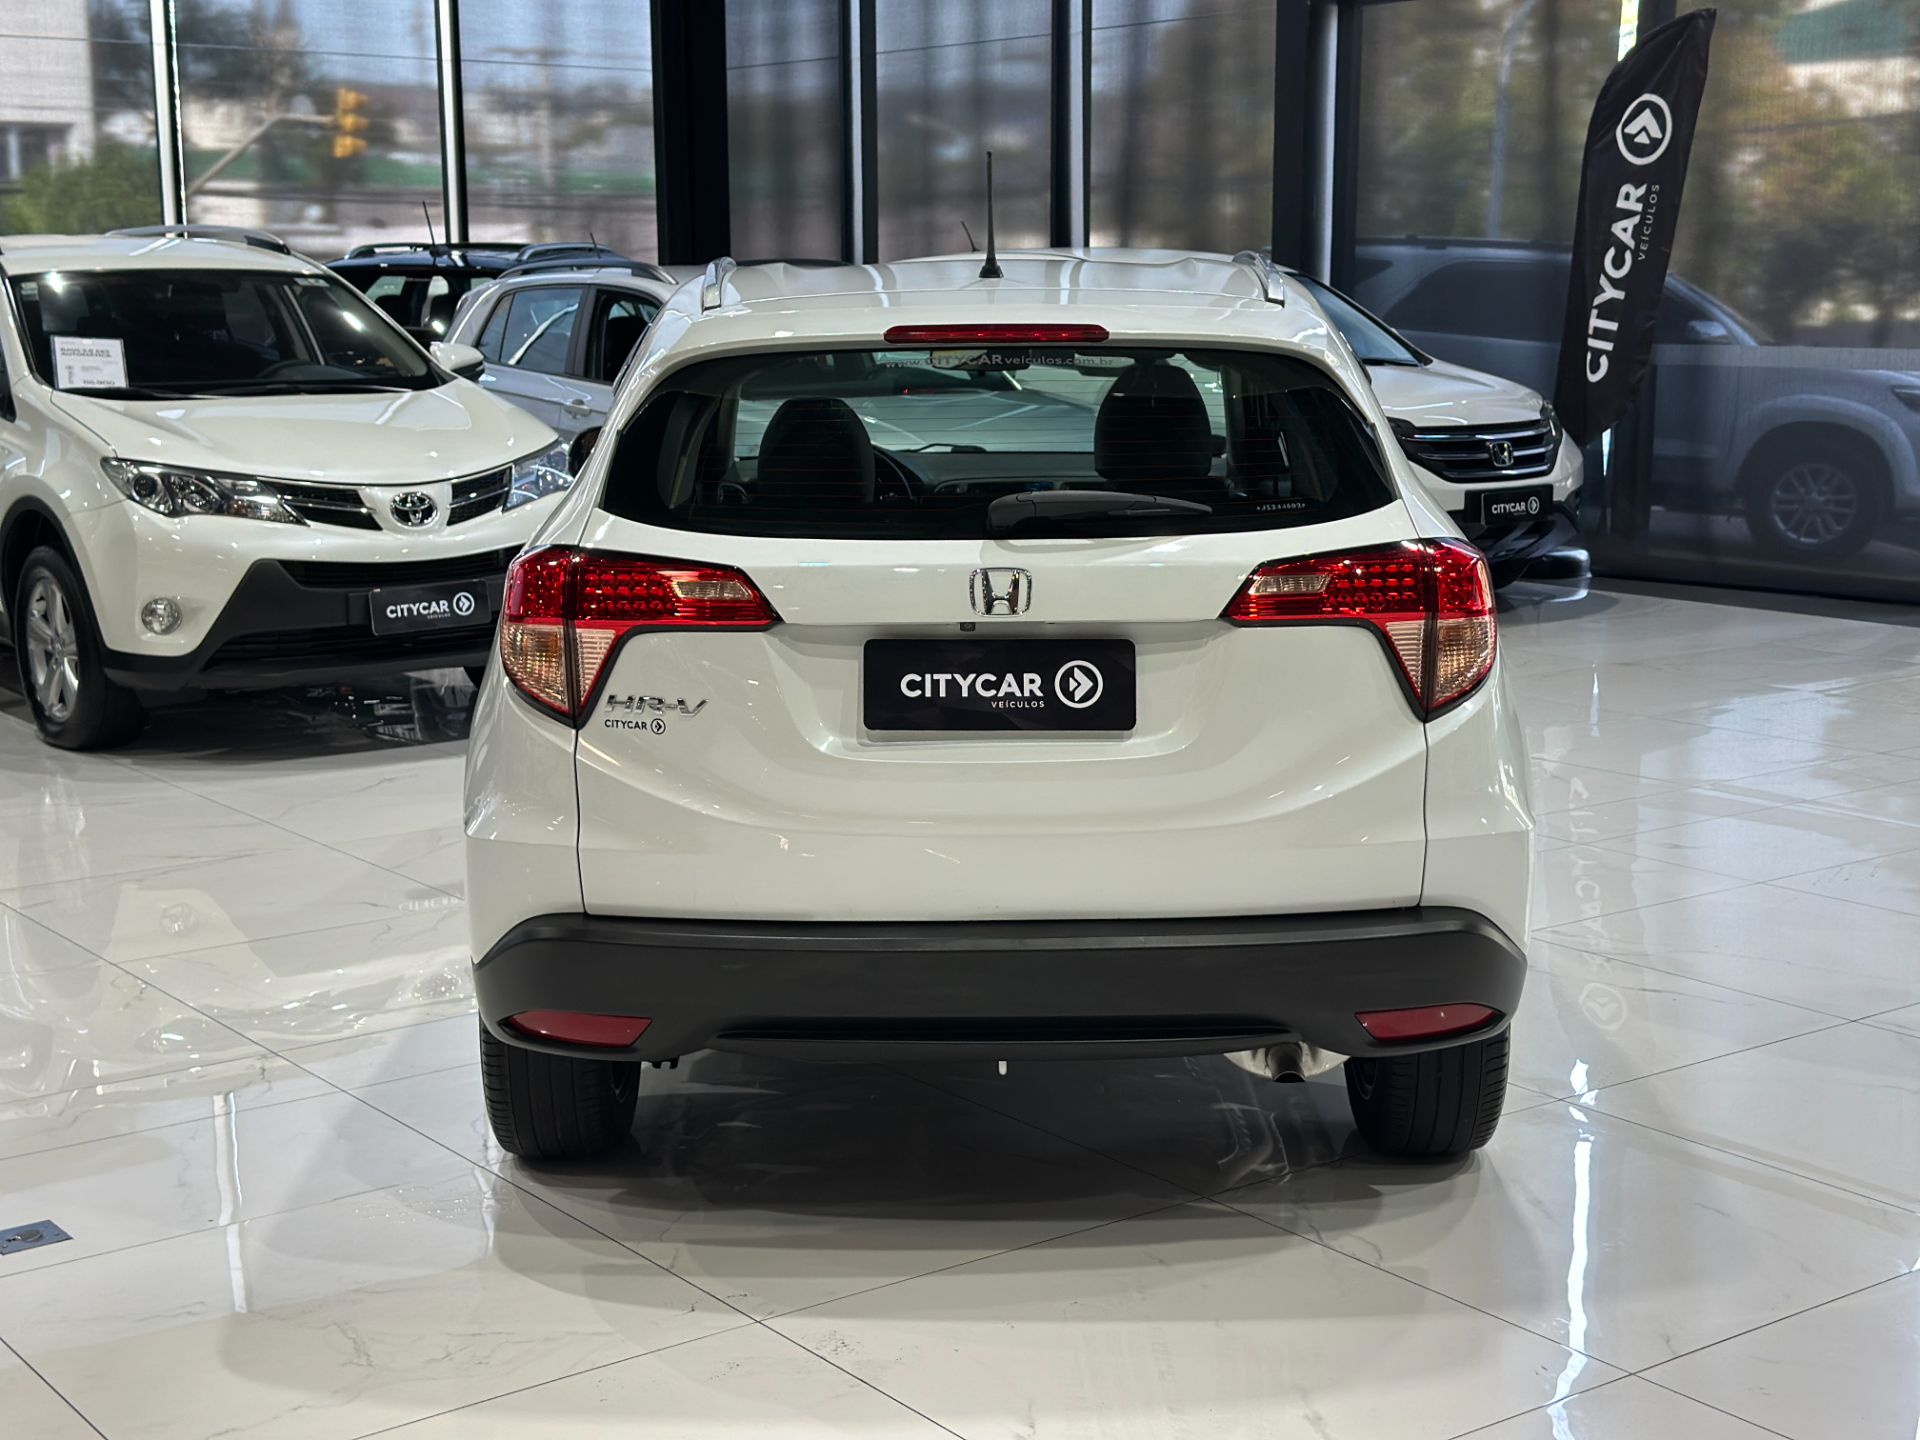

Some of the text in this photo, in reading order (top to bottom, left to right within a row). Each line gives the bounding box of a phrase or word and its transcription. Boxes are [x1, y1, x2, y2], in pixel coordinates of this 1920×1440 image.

[1638, 184, 1660, 260] VEÍCULOS
[1586, 183, 1647, 383] CITYCAR
[1491, 502, 1526, 514] CITYCAR
[386, 600, 450, 618] CITYCAR
[900, 672, 1044, 698] CITYCAR
[604, 694, 709, 718] HR-V
[991, 699, 1045, 708] VEÍCULOS
[604, 719, 648, 731] CITYCAR
